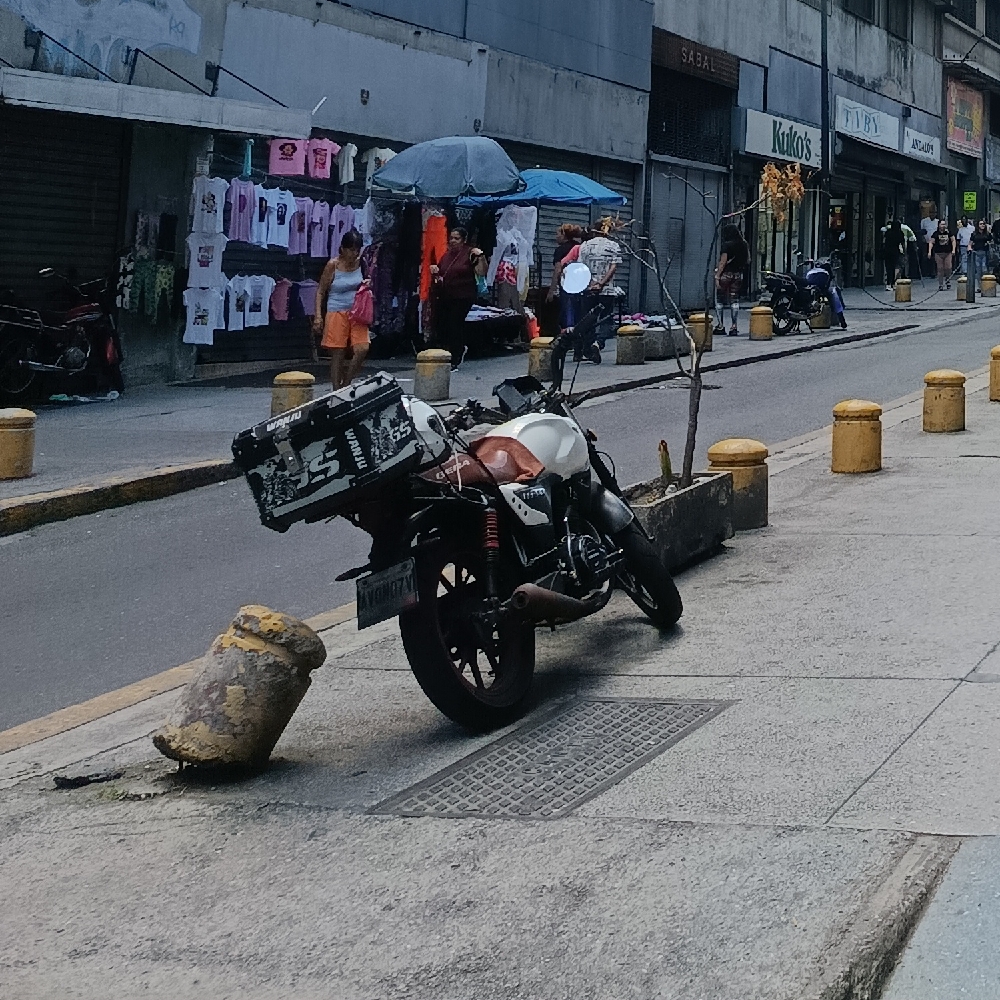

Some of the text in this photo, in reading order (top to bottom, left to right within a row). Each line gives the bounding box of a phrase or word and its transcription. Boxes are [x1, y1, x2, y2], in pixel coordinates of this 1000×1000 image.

[681, 46, 716, 72] SABAL
[843, 107, 879, 134] TIBY
[772, 119, 812, 161] Kuko's
[344, 428, 368, 470] WANJU
